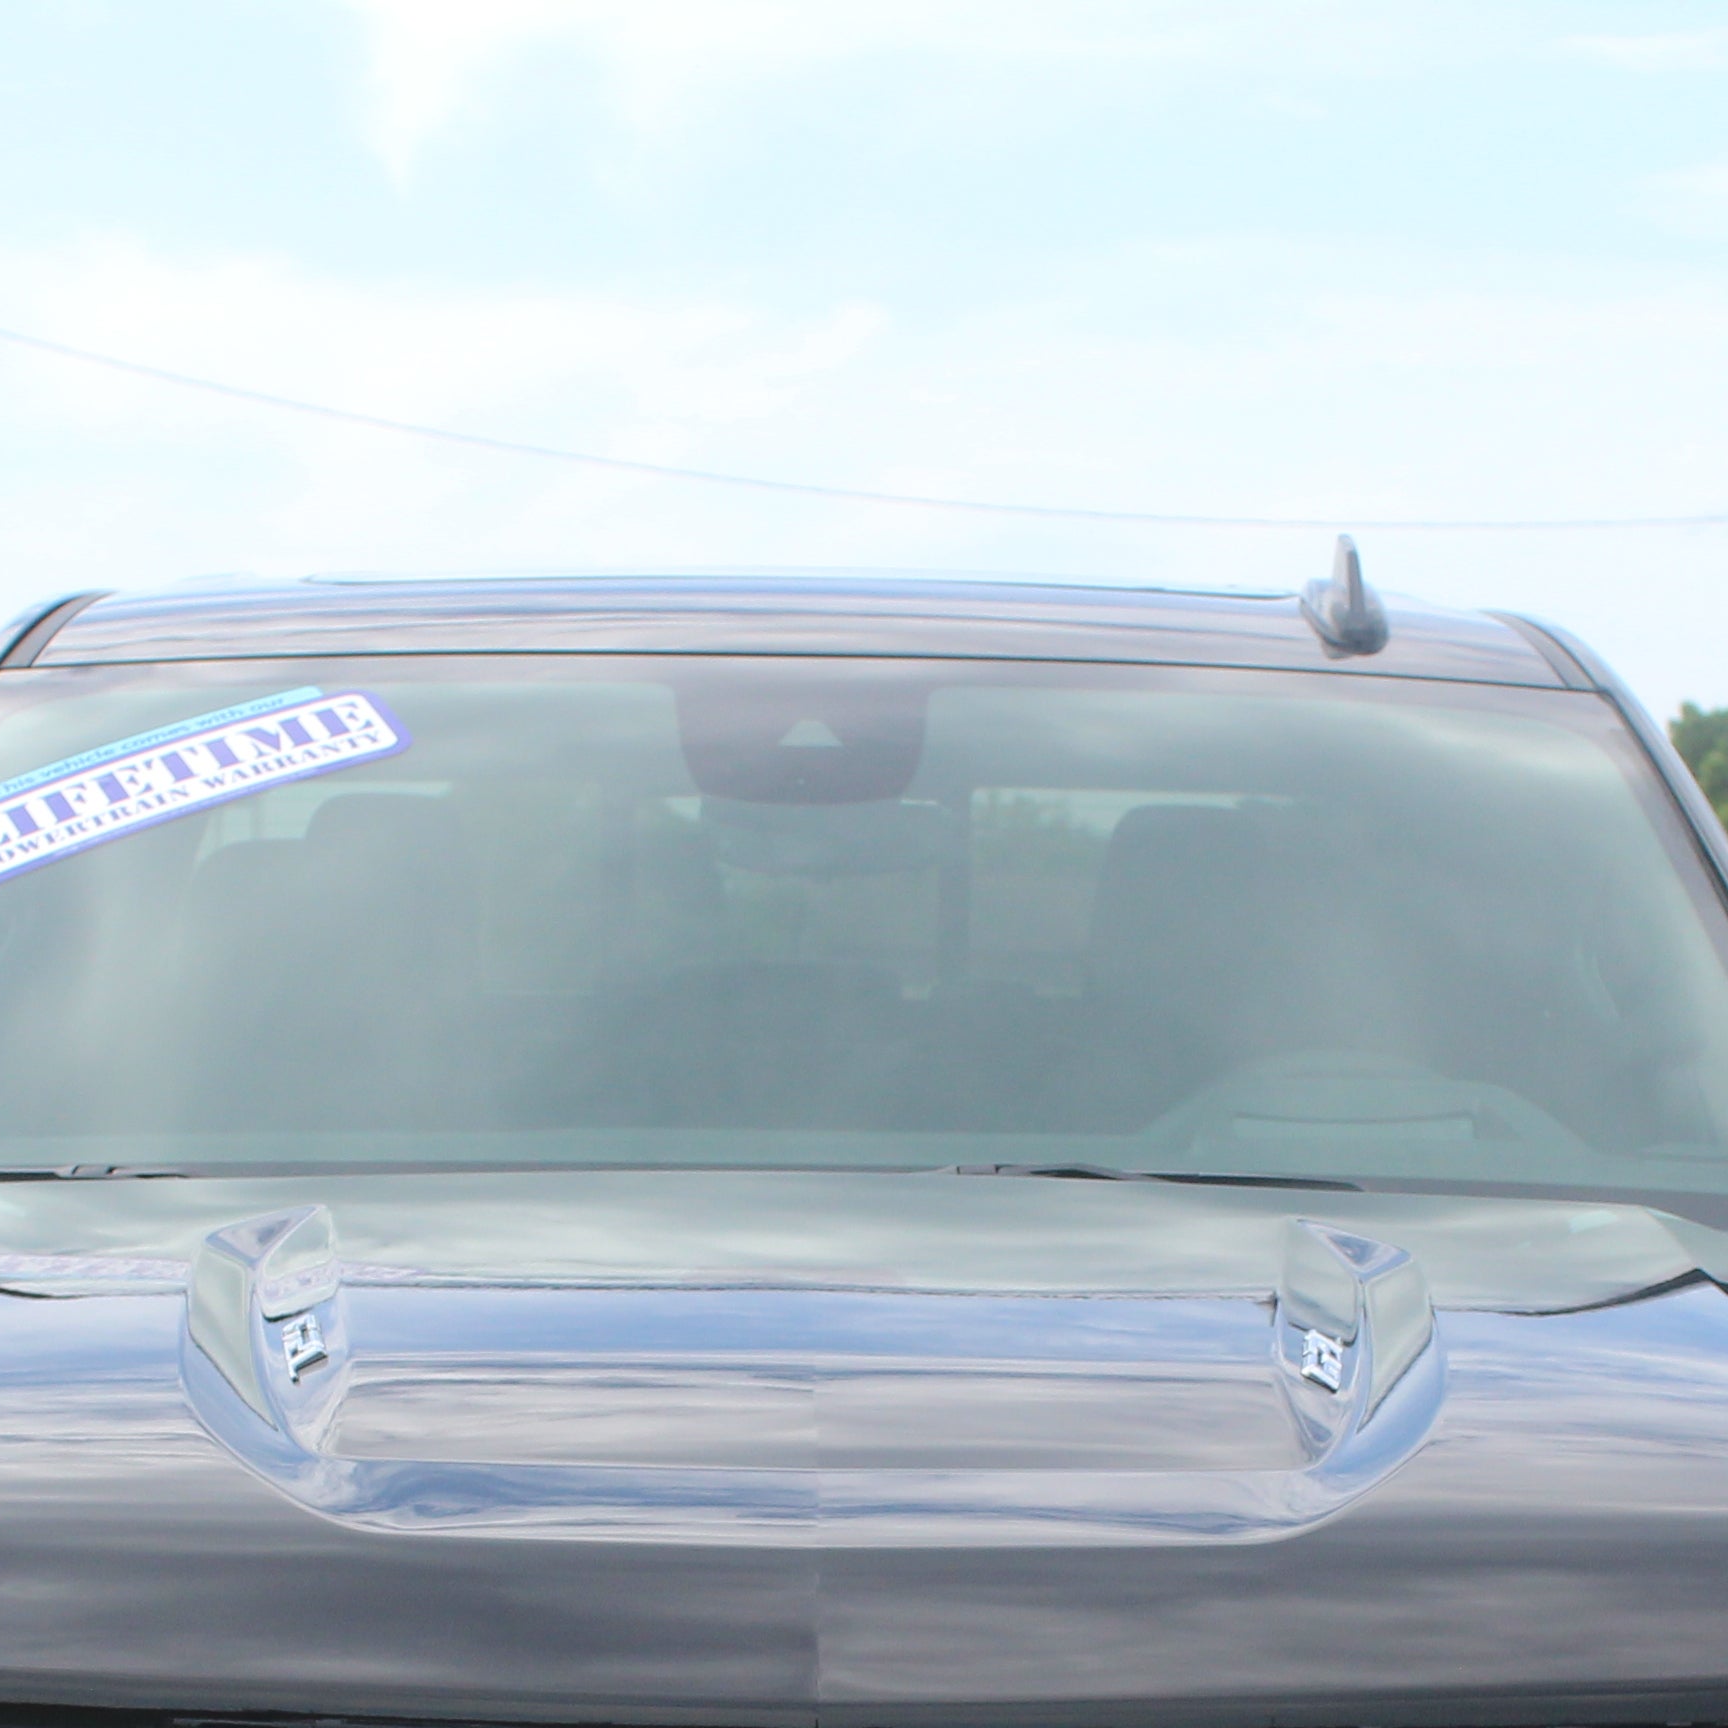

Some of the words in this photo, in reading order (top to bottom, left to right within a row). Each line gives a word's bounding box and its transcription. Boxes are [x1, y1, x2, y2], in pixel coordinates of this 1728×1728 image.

[40, 748, 116, 778] vehicle
[121, 725, 191, 750] comes
[195, 708, 246, 727] with
[250, 698, 285, 712] our
[201, 730, 382, 790] WARRANTY
